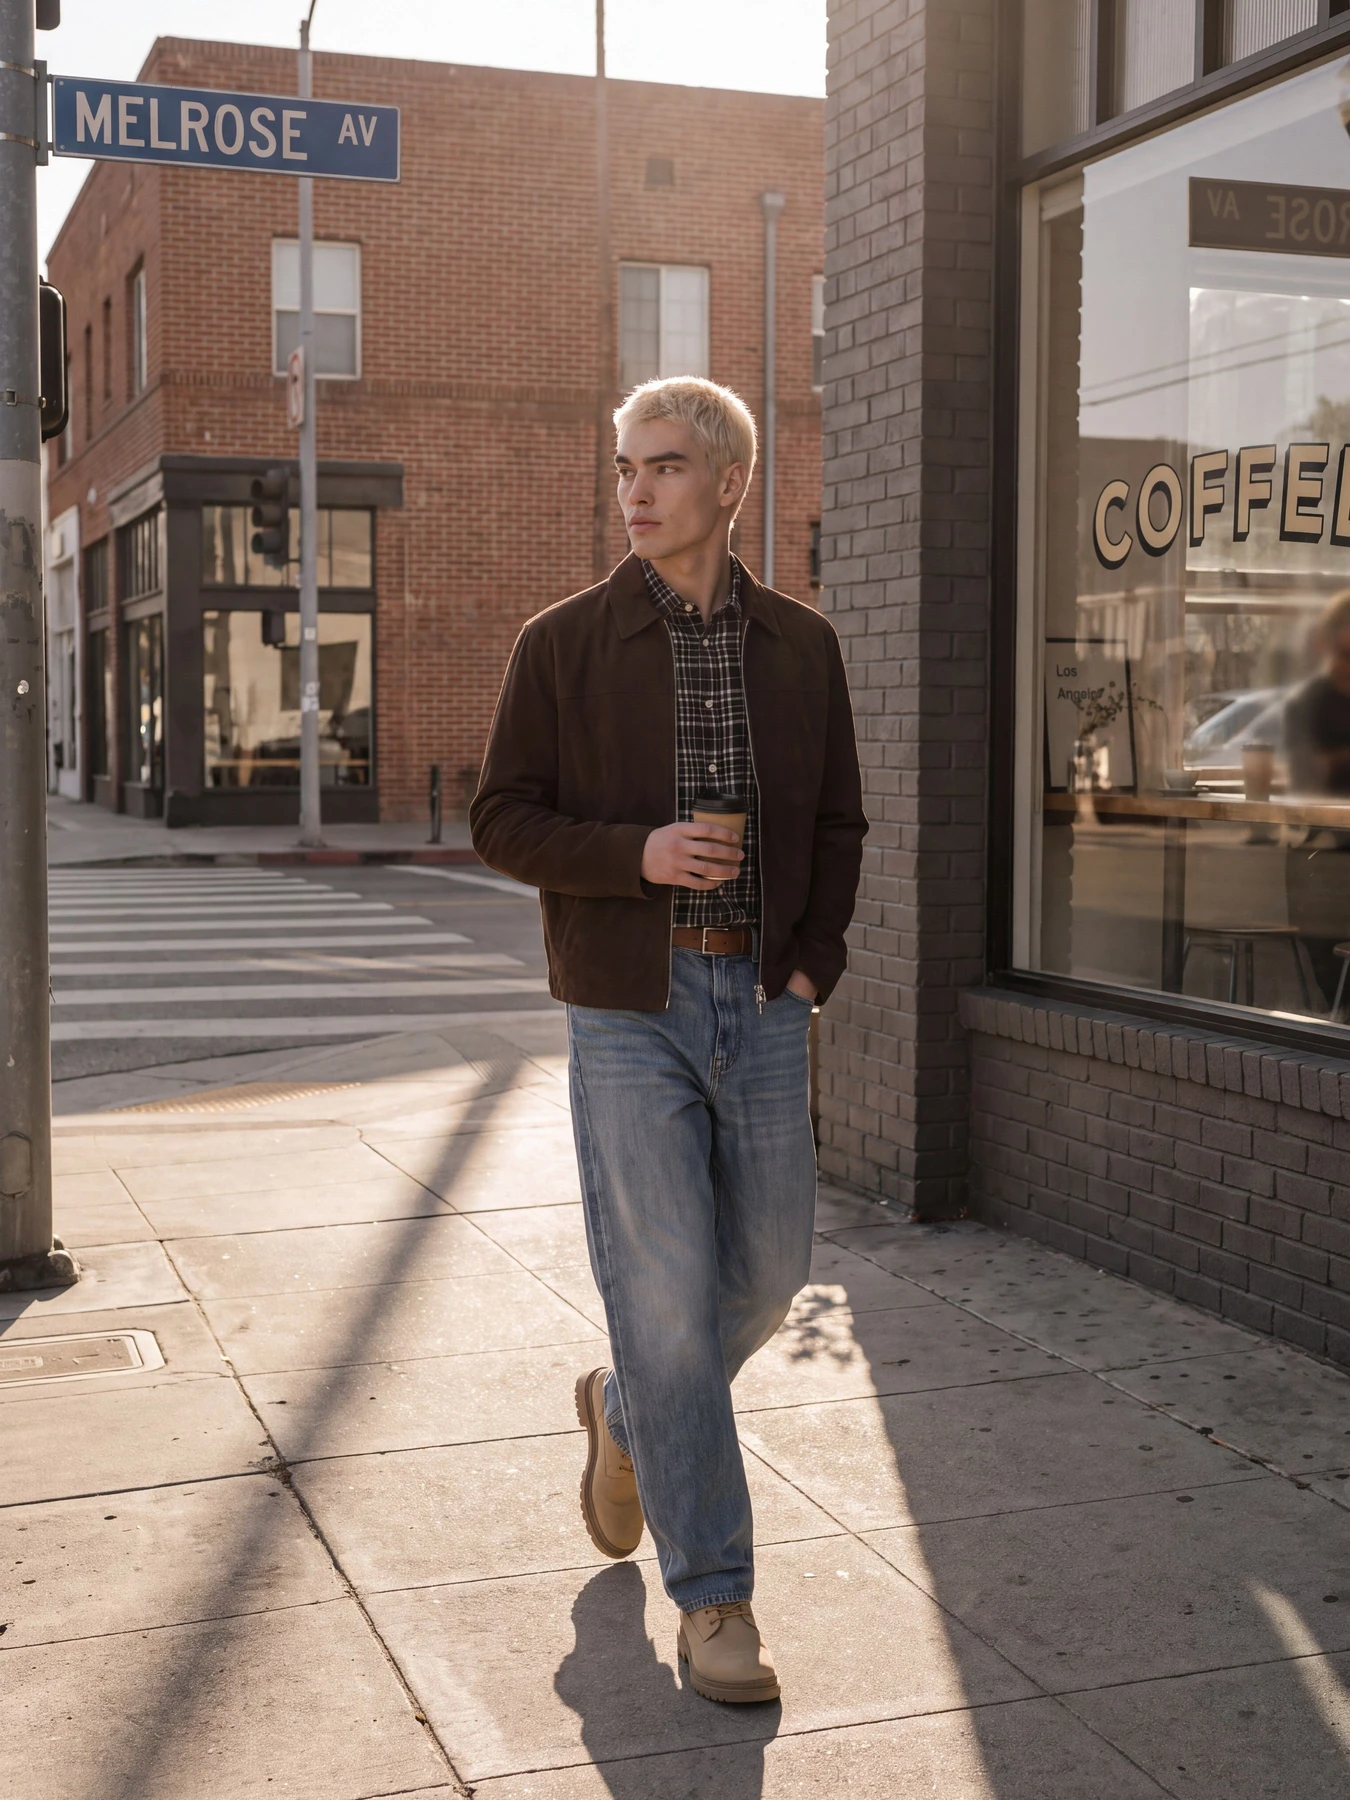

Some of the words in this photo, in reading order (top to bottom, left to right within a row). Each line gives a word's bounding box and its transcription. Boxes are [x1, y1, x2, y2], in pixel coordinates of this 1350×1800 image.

[75, 91, 308, 161] MELROSE
[338, 113, 378, 147] AV
[1056, 664, 1077, 677] Los
[1057, 687, 1103, 702] Angel
